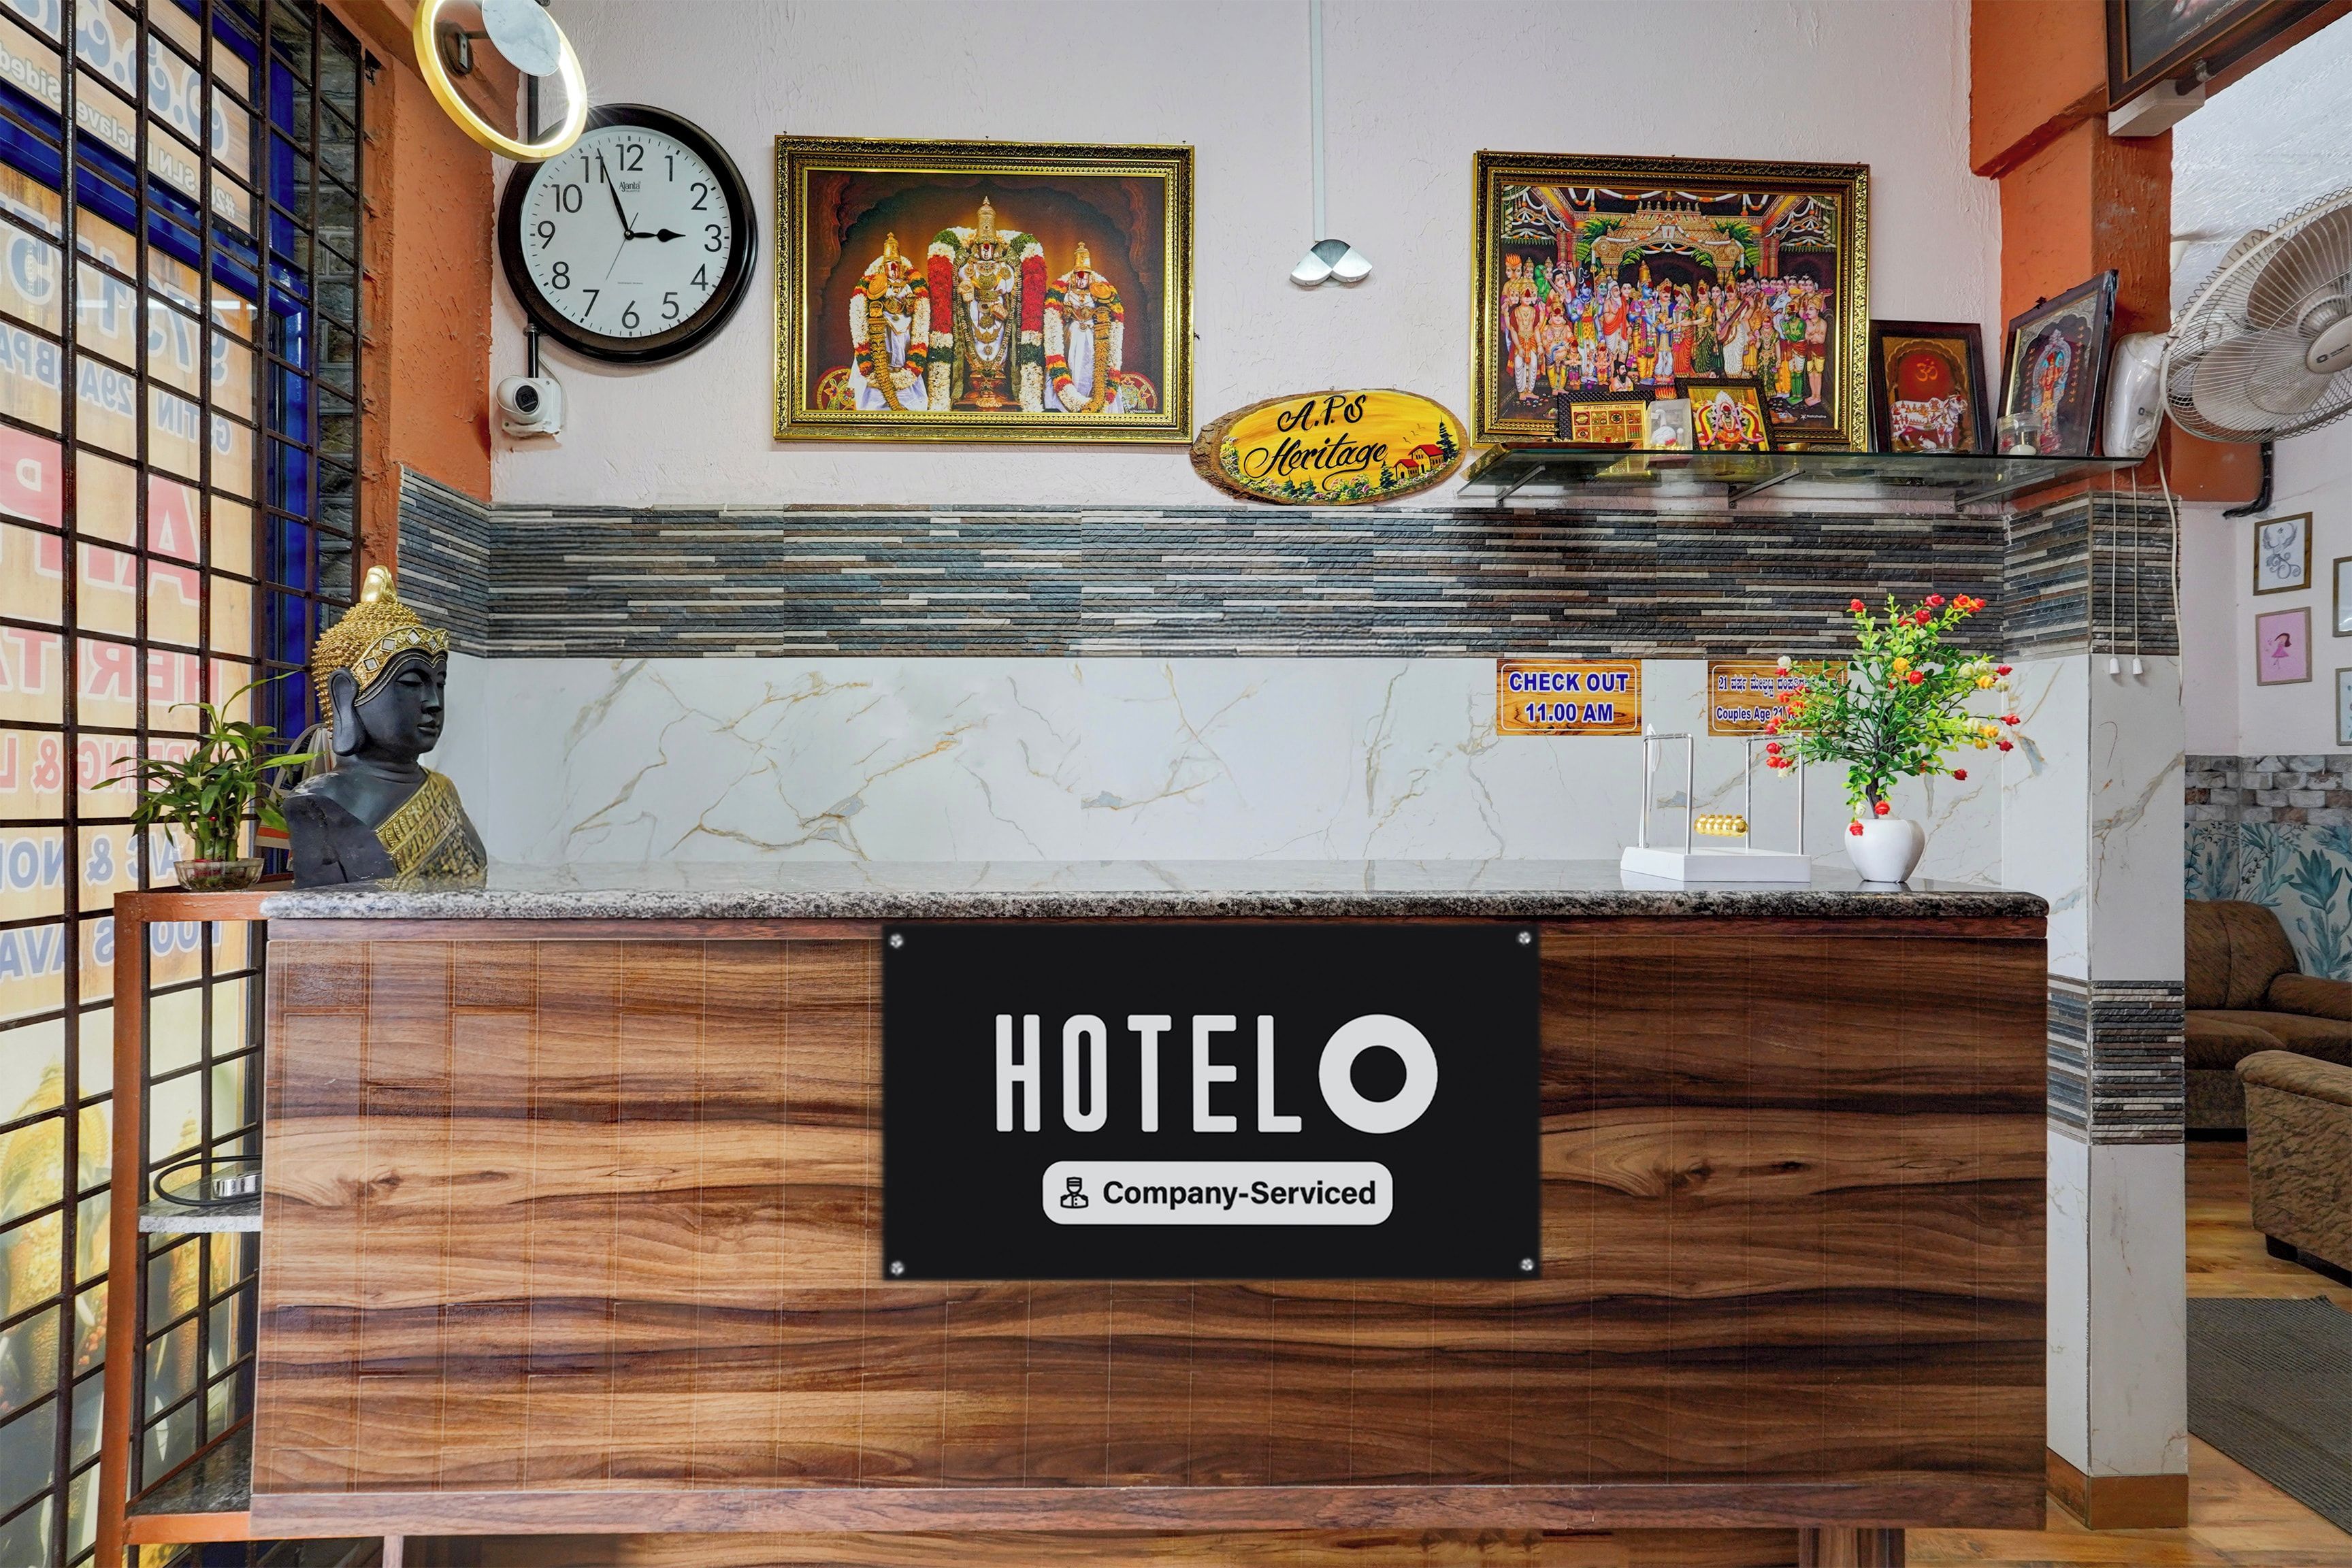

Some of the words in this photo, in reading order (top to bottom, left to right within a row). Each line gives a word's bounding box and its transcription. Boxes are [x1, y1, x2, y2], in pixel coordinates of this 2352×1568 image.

[580, 156, 604, 183] 11
[616, 144, 643, 171] 12
[665, 155, 674, 182] 1
[551, 184, 583, 213] 10
[619, 181, 640, 192] Ajanta
[690, 183, 708, 210] 2
[538, 220, 555, 249] 9
[704, 225, 722, 252] 3
[552, 261, 570, 289] 8
[690, 263, 708, 291] 4
[583, 289, 600, 316] 7
[621, 300, 640, 329] 6
[662, 292, 680, 319] 5
[1244, 433, 1388, 492] Heritage
[1509, 673, 1580, 691] CHECK
[1587, 673, 1628, 691] OUT
[1718, 676, 1727, 689] 21
[1526, 704, 1576, 721] 11.00
[1583, 704, 1612, 721] AM
[1716, 707, 1751, 722] Couples
[1754, 707, 1770, 722] Age
[1773, 707, 1783, 719] 21
[996, 1014, 1302, 1132] HOTEL
[1102, 1180, 1375, 1210] Company-Serviced
